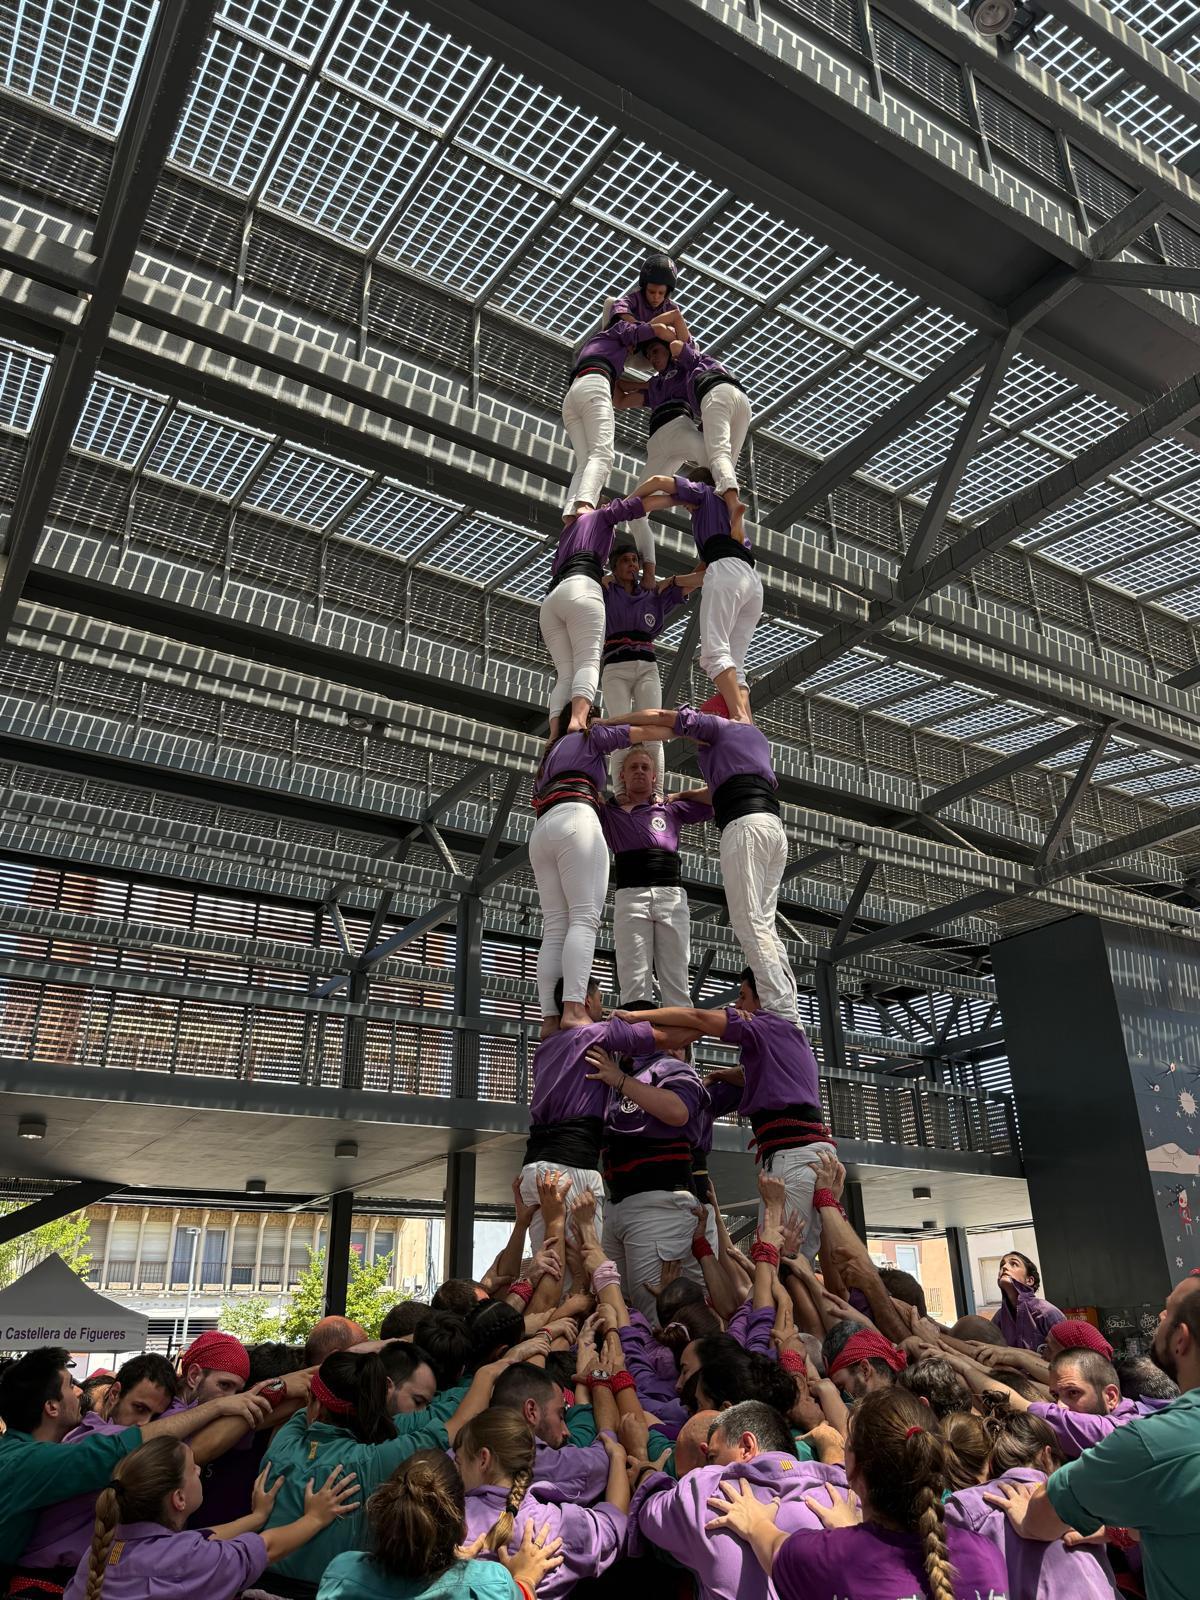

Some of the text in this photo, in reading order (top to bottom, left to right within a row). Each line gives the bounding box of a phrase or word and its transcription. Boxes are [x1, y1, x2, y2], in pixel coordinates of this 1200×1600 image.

[5, 1327, 61, 1339] Castellera
[63, 1327, 77, 1340] de
[80, 1327, 126, 1342] Figueres
